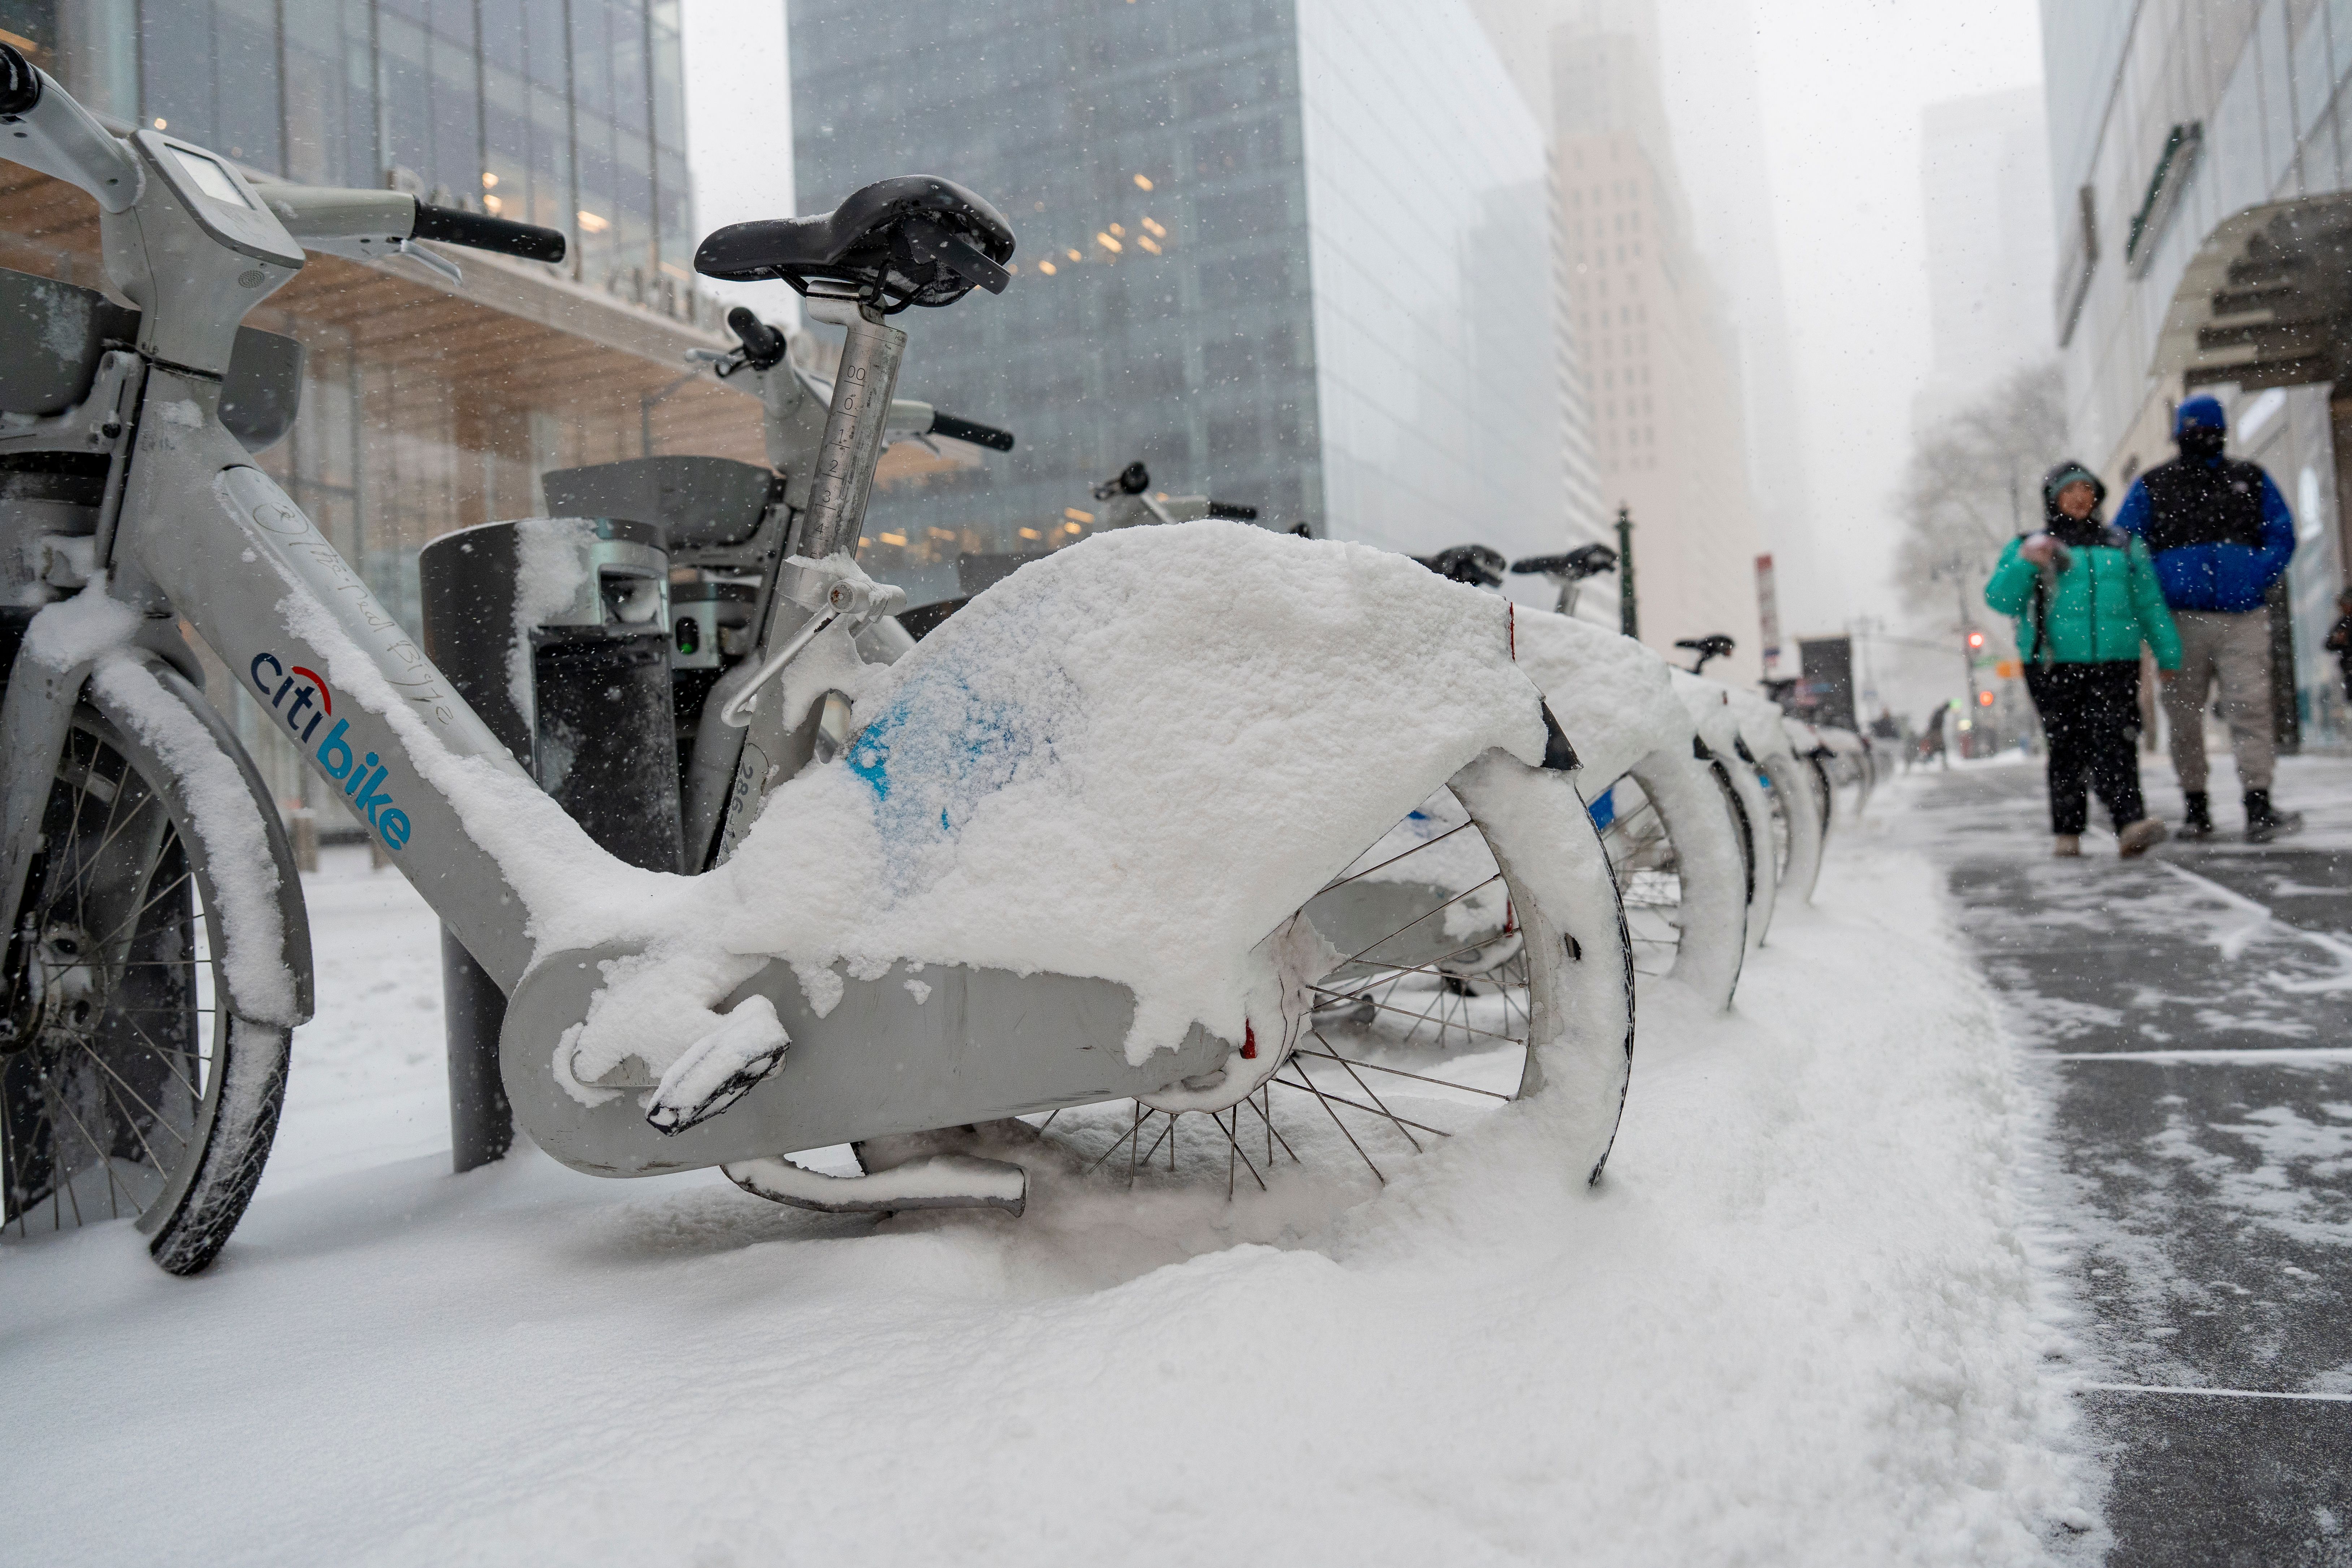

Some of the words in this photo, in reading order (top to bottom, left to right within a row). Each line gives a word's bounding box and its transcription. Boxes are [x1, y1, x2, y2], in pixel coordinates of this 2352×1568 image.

[847, 365, 865, 380] 00
[844, 398, 853, 410] 0
[840, 429, 844, 442] 1
[830, 460, 838, 473] 2
[822, 490, 831, 502] 3
[815, 523, 823, 535] 4
[251, 653, 331, 744] citi
[316, 718, 411, 850] bike
